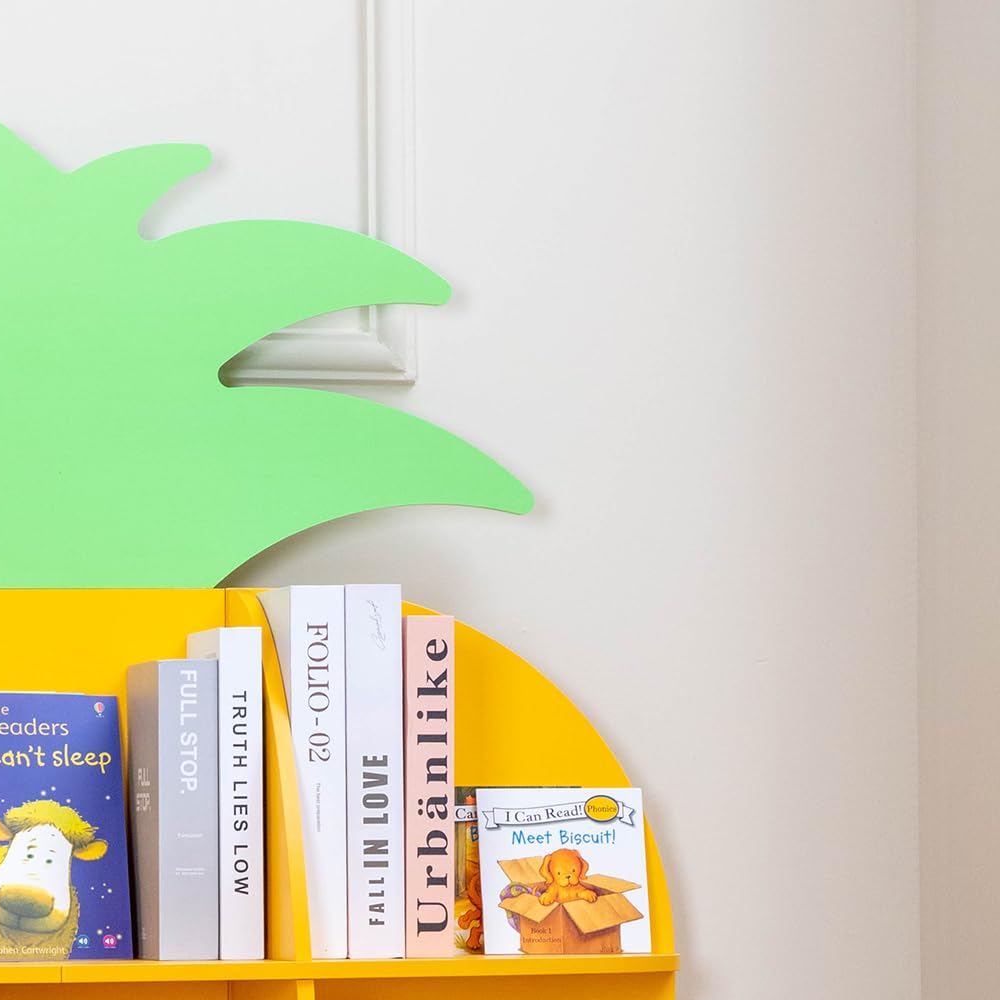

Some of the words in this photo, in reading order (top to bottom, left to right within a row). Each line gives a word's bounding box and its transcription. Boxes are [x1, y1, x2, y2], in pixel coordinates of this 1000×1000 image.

[306, 622, 330, 713] FOLIO
[180, 670, 198, 725] FULL
[232, 690, 248, 768] TRUTH
[308, 734, 331, 762] 02
[52, 748, 112, 774] sleep
[181, 732, 198, 795] STOP.
[233, 781, 248, 832] LIES
[362, 754, 389, 825] LOVE
[417, 638, 448, 936] Urbänlike
[505, 811, 510, 822] I
[514, 810, 542, 823] Can
[546, 805, 583, 819] Read!
[587, 804, 617, 814] Phonics
[512, 830, 552, 845] Meet
[559, 829, 616, 845] Biscuit!
[234, 845, 249, 896] LOW
[363, 839, 389, 868] IN
[368, 877, 385, 926] FALL
[21, 946, 66, 957] Cartwright
